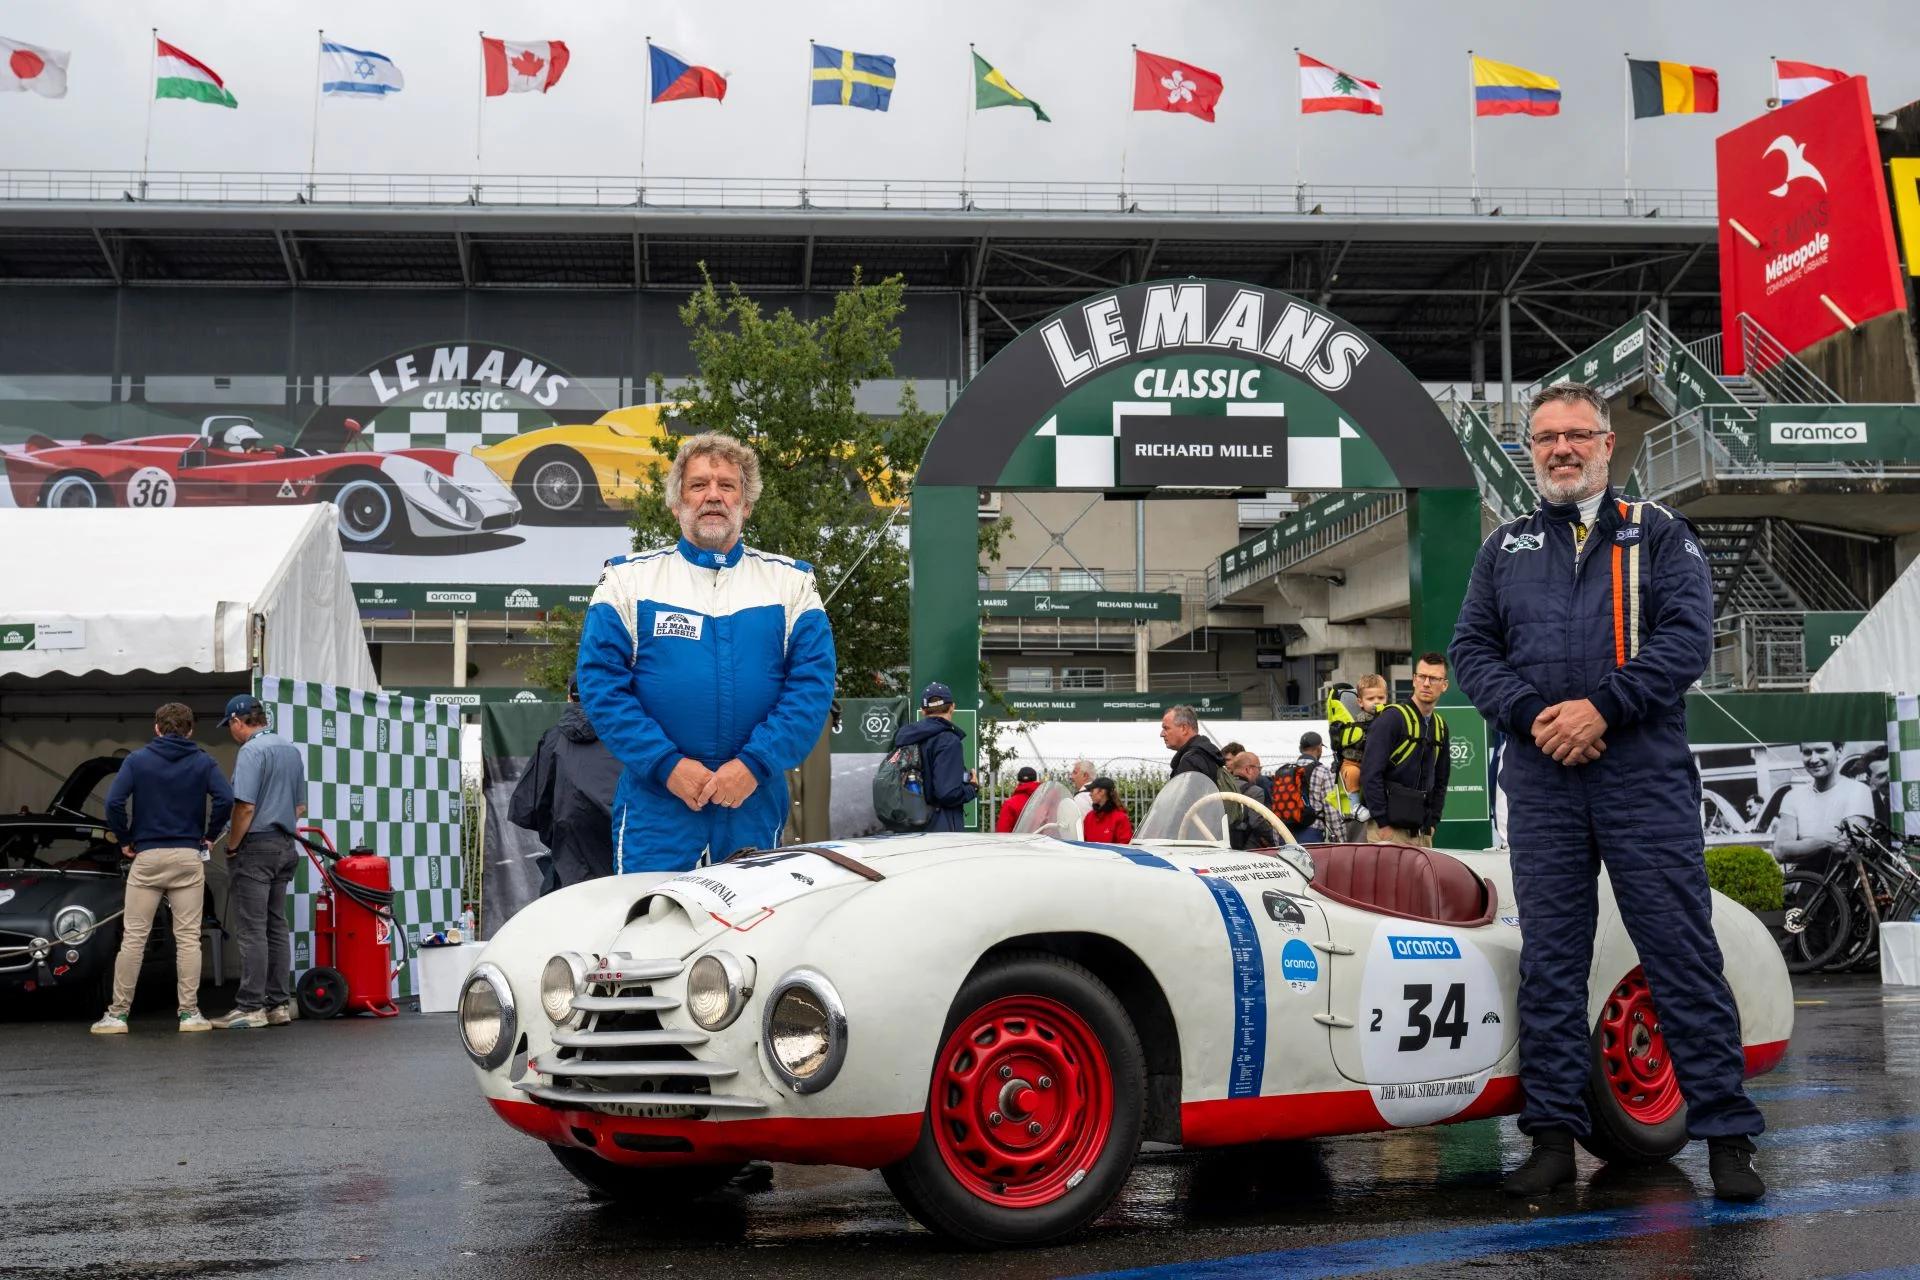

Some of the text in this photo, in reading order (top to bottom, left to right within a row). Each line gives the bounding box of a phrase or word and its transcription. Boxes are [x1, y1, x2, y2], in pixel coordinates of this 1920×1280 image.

[1765, 231, 1829, 284] Métropole
[1803, 253, 1829, 274] URBAINE
[1040, 284, 1370, 391] LE MANS
[1615, 333, 1642, 357] aramco
[369, 346, 569, 406] LE MANS
[1133, 368, 1262, 399] CLASSIC
[422, 392, 504, 410] CLASSIC
[1780, 425, 1857, 440] aramco
[1135, 443, 1273, 458] RICHARD MILLE
[133, 479, 169, 507] 36
[430, 593, 472, 601] aramco
[983, 599, 1008, 607] MARIUS
[1096, 601, 1133, 609] RICHARD
[668, 622, 697, 632] MANS
[434, 695, 476, 704] aramco
[1209, 864, 1251, 874] Stanislav
[1396, 939, 1454, 956] aramco
[1284, 959, 1316, 969] aramco
[1370, 1008, 1383, 1032] 2
[1398, 983, 1469, 1052] 34
[1380, 1084, 1396, 1100] THE
[1398, 1083, 1417, 1100] WALL
[1417, 1081, 1445, 1098] STREET
